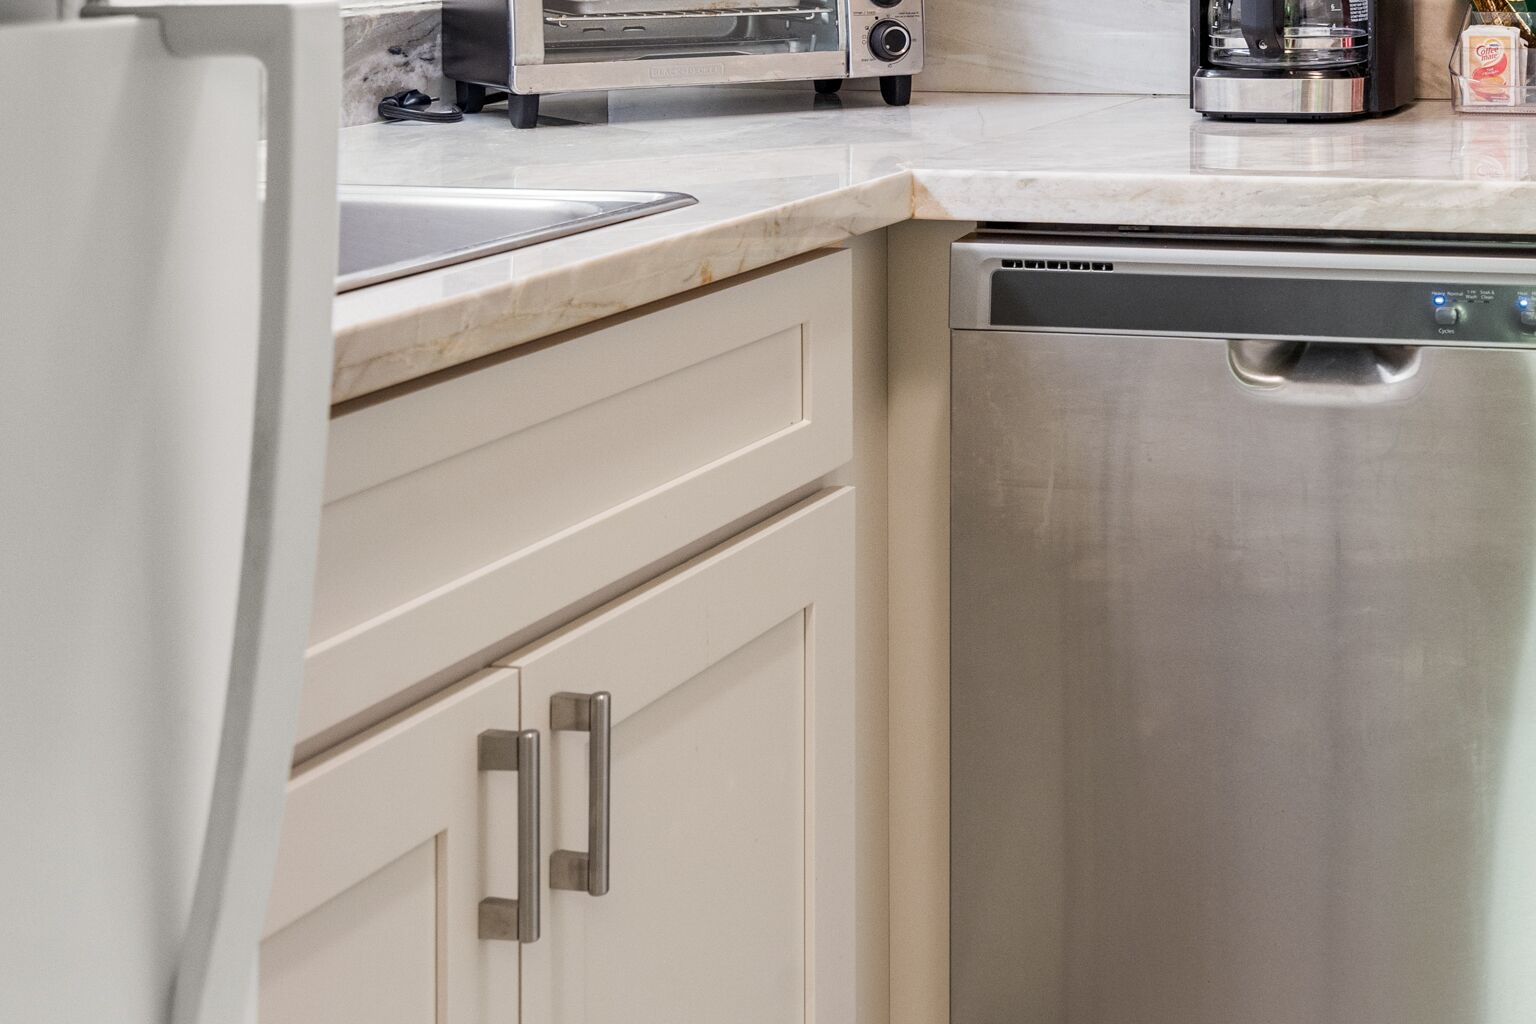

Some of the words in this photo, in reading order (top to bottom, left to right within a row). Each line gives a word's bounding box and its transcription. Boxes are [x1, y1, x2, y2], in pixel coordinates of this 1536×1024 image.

[1476, 44, 1500, 57] Coffee
[1480, 53, 1498, 63] mate
[1438, 327, 1455, 336] Cycles
